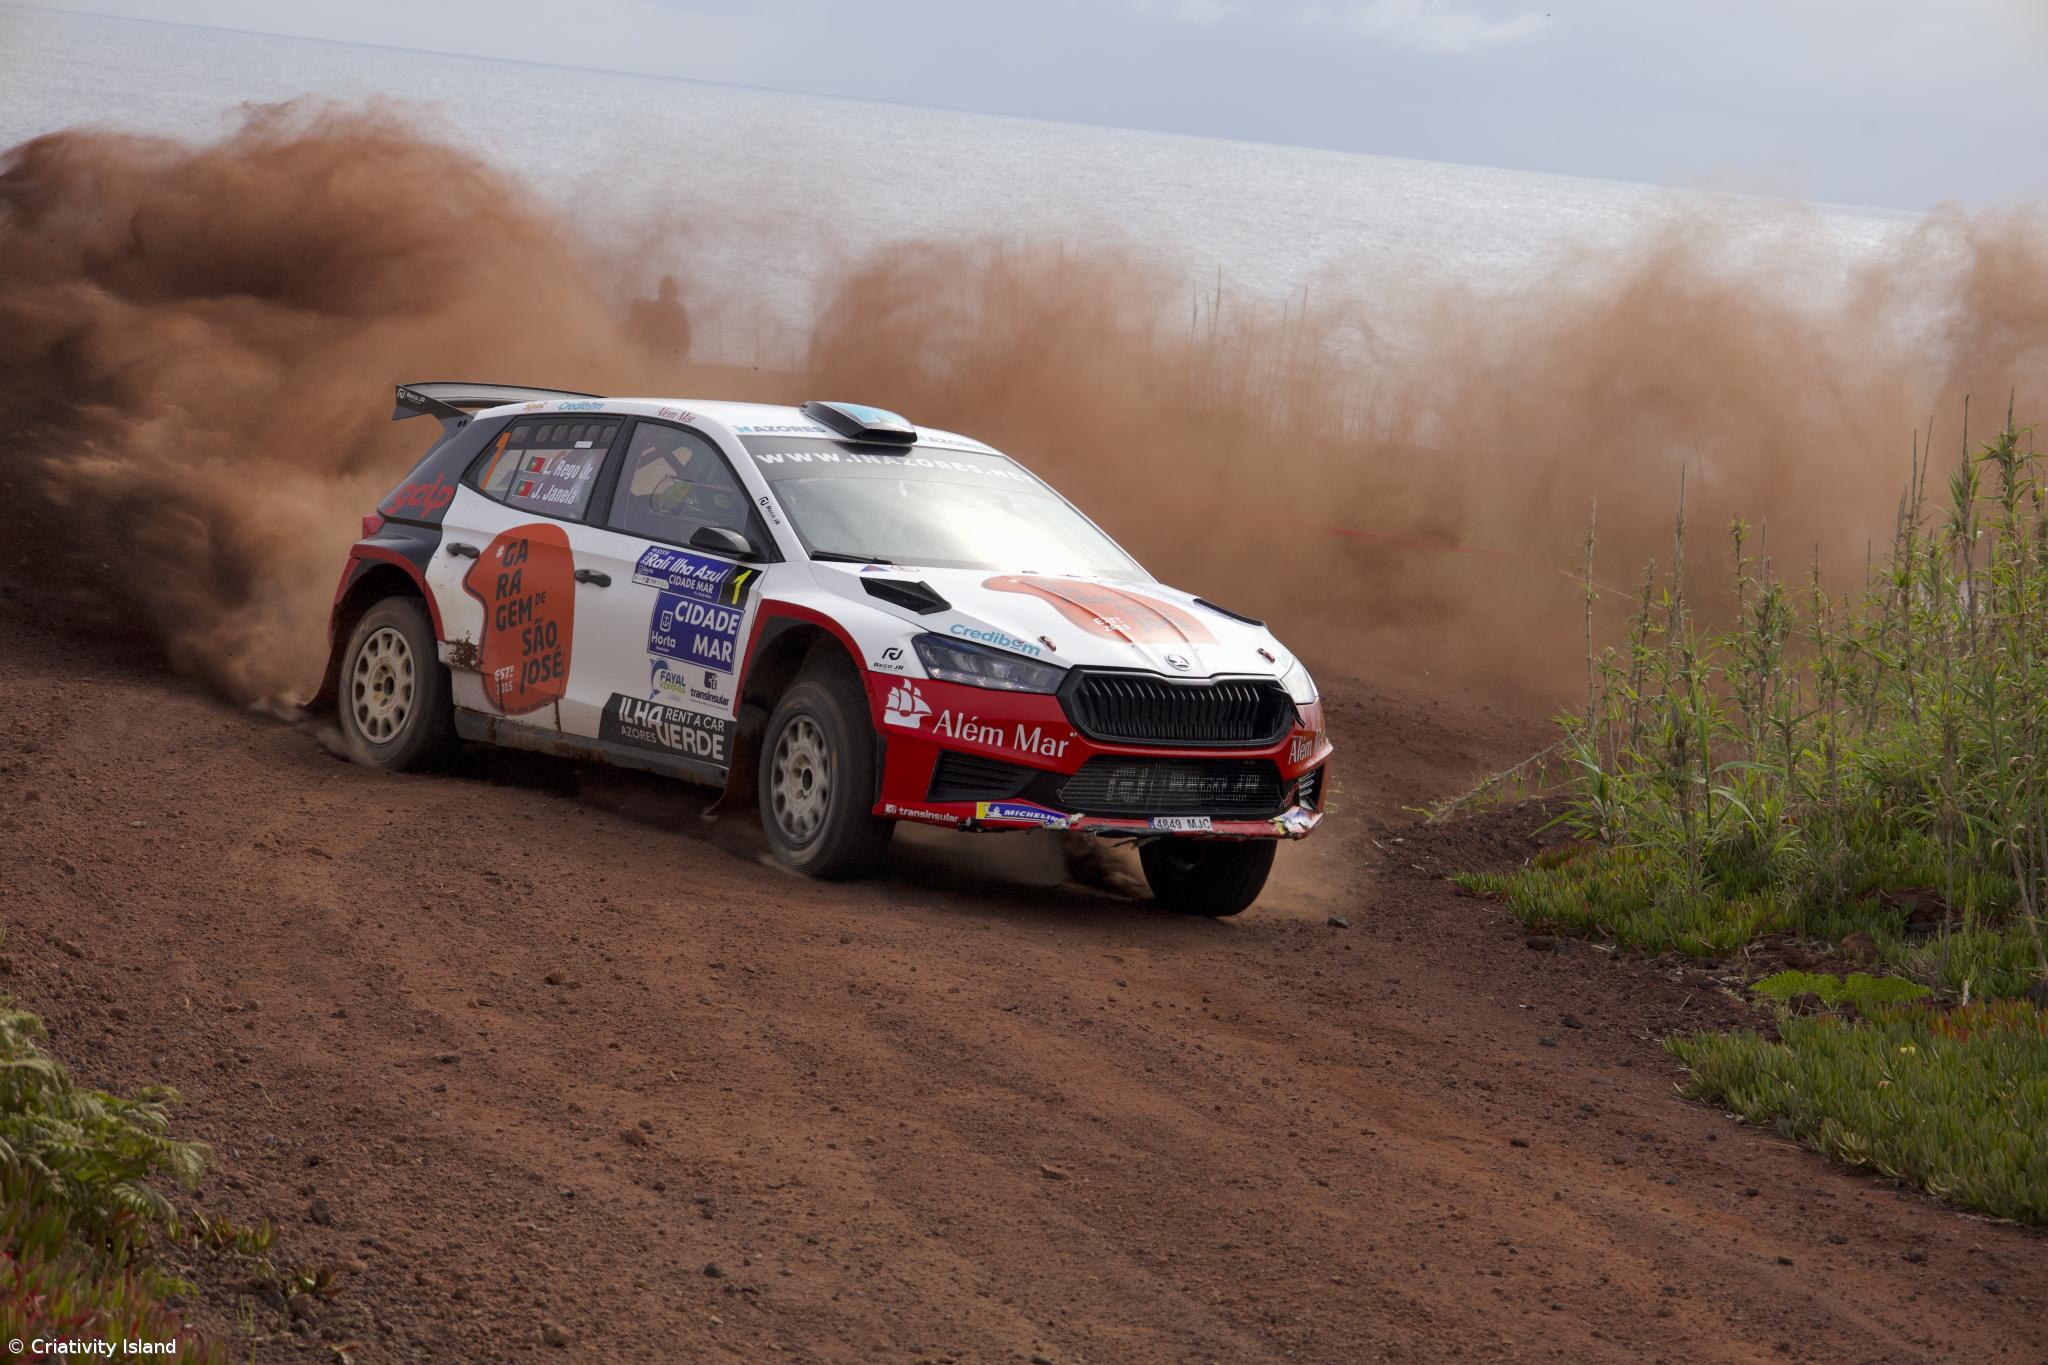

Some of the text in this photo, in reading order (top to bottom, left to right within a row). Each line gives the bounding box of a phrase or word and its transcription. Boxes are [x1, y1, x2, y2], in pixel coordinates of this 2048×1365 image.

[554, 459, 580, 481] Rego
[579, 463, 594, 481] Jr.
[531, 482, 578, 505] J. Janela
[644, 553, 674, 572] Rali
[668, 557, 695, 576] Ilha
[692, 565, 729, 583] Azul
[495, 568, 523, 600] RA
[668, 574, 696, 590] CIDADE
[695, 582, 714, 595] MAR
[732, 569, 752, 605] 1
[495, 591, 547, 632] GEM DE
[674, 600, 740, 636] CIDADE
[522, 617, 559, 657] SÃO
[651, 630, 677, 649] Horta
[692, 633, 733, 663] MAR
[949, 623, 1042, 658] Credibom
[519, 643, 564, 695] JOSÉ
[660, 670, 687, 687] FAYAL
[690, 687, 730, 705] transinsular
[618, 697, 664, 730] ILHA
[665, 707, 694, 725] RENT
[693, 714, 702, 727] A
[703, 717, 725, 733] CAR
[621, 725, 657, 744] AZORES
[932, 709, 1070, 759] Além Mar
[1288, 735, 1313, 766] Além
[898, 805, 960, 824] transinsular
[1003, 808, 1061, 825] MICHELIN
[1155, 817, 1211, 831] 4849 MJC
